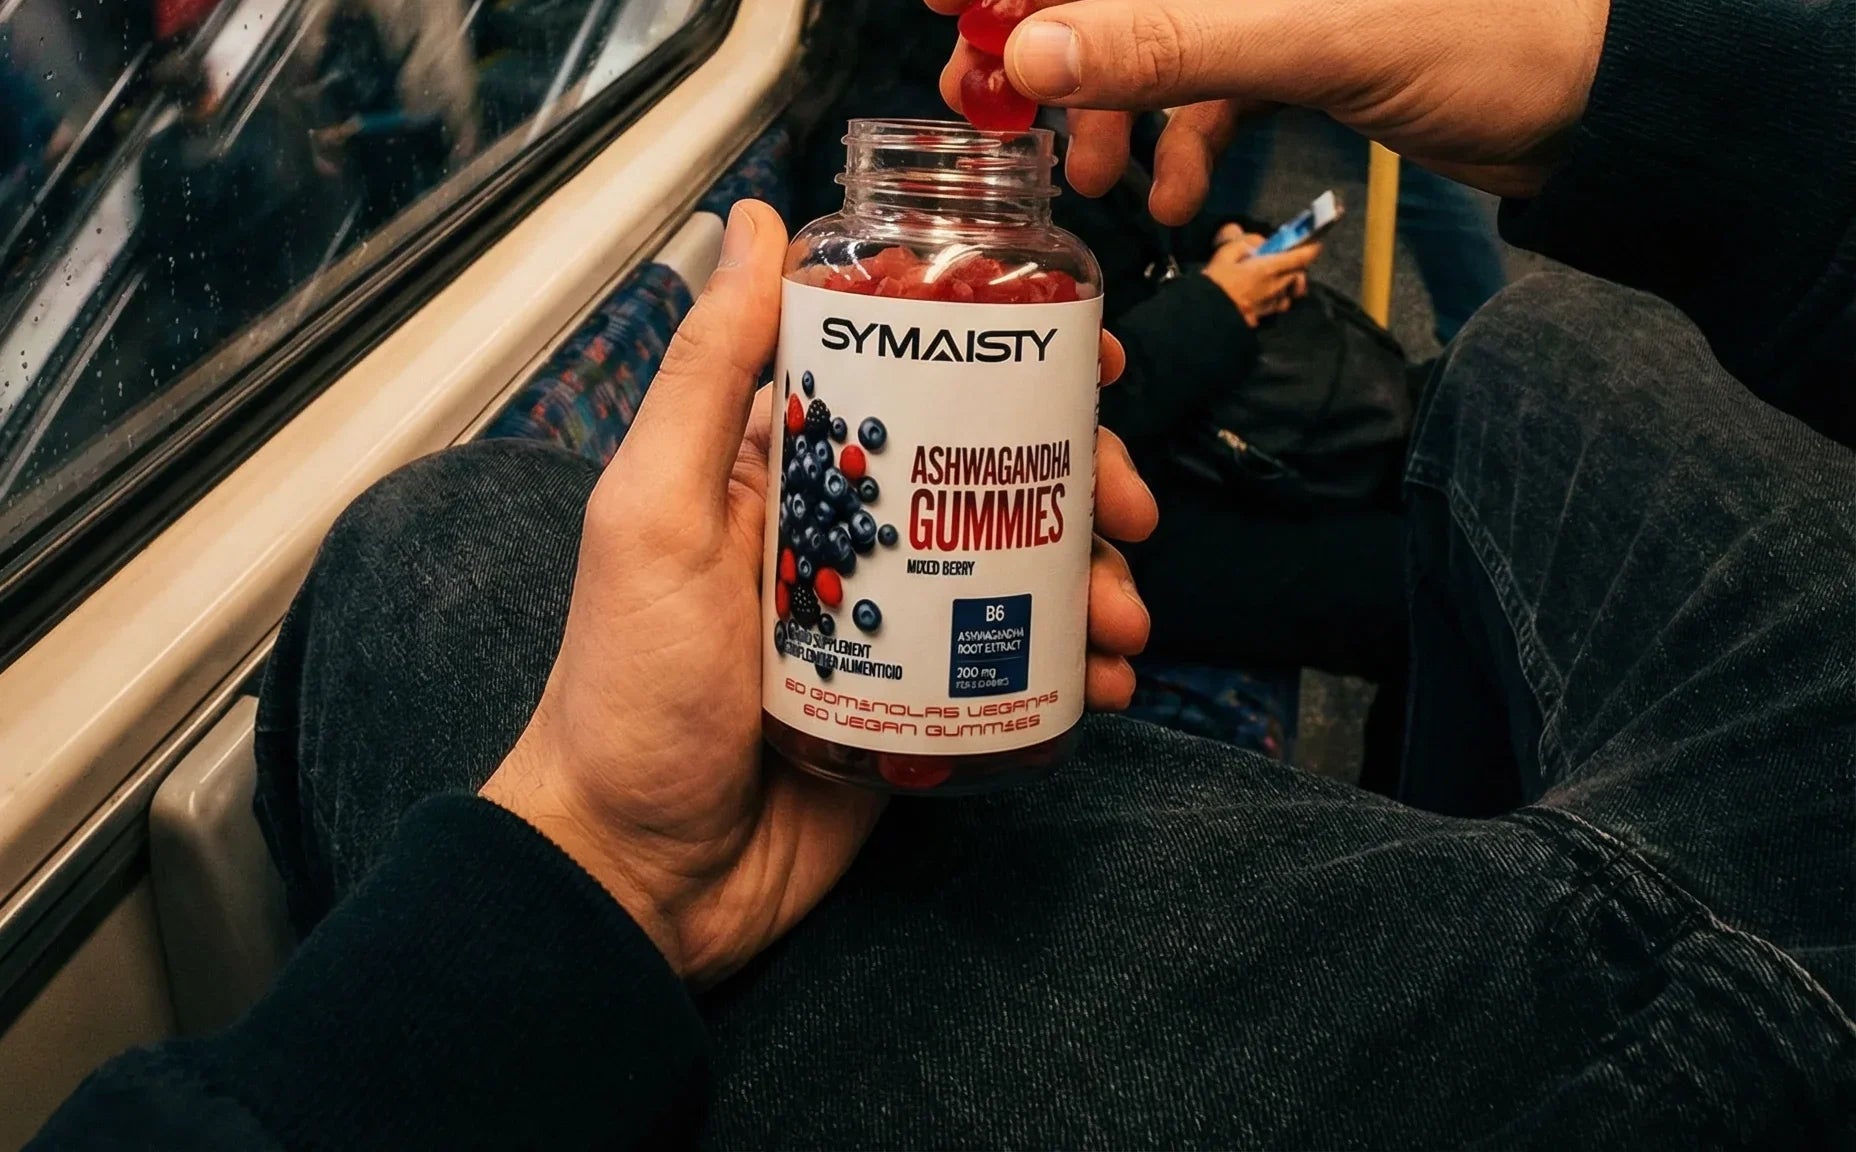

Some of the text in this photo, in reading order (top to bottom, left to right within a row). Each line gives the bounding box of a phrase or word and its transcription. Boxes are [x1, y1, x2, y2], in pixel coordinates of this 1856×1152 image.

[822, 317, 1058, 362] SYMAISTY
[911, 439, 1070, 485] ASHWAGANDHA
[909, 483, 1065, 551] GUMMIES
[942, 561, 975, 576] BERRY
[986, 605, 1005, 622] B6
[839, 656, 903, 680] ALIMENTICIO
[956, 667, 979, 678] 200
[967, 690, 1059, 718] VEGANAS
[803, 704, 1041, 737] 60 VEGAN GUMMIES
